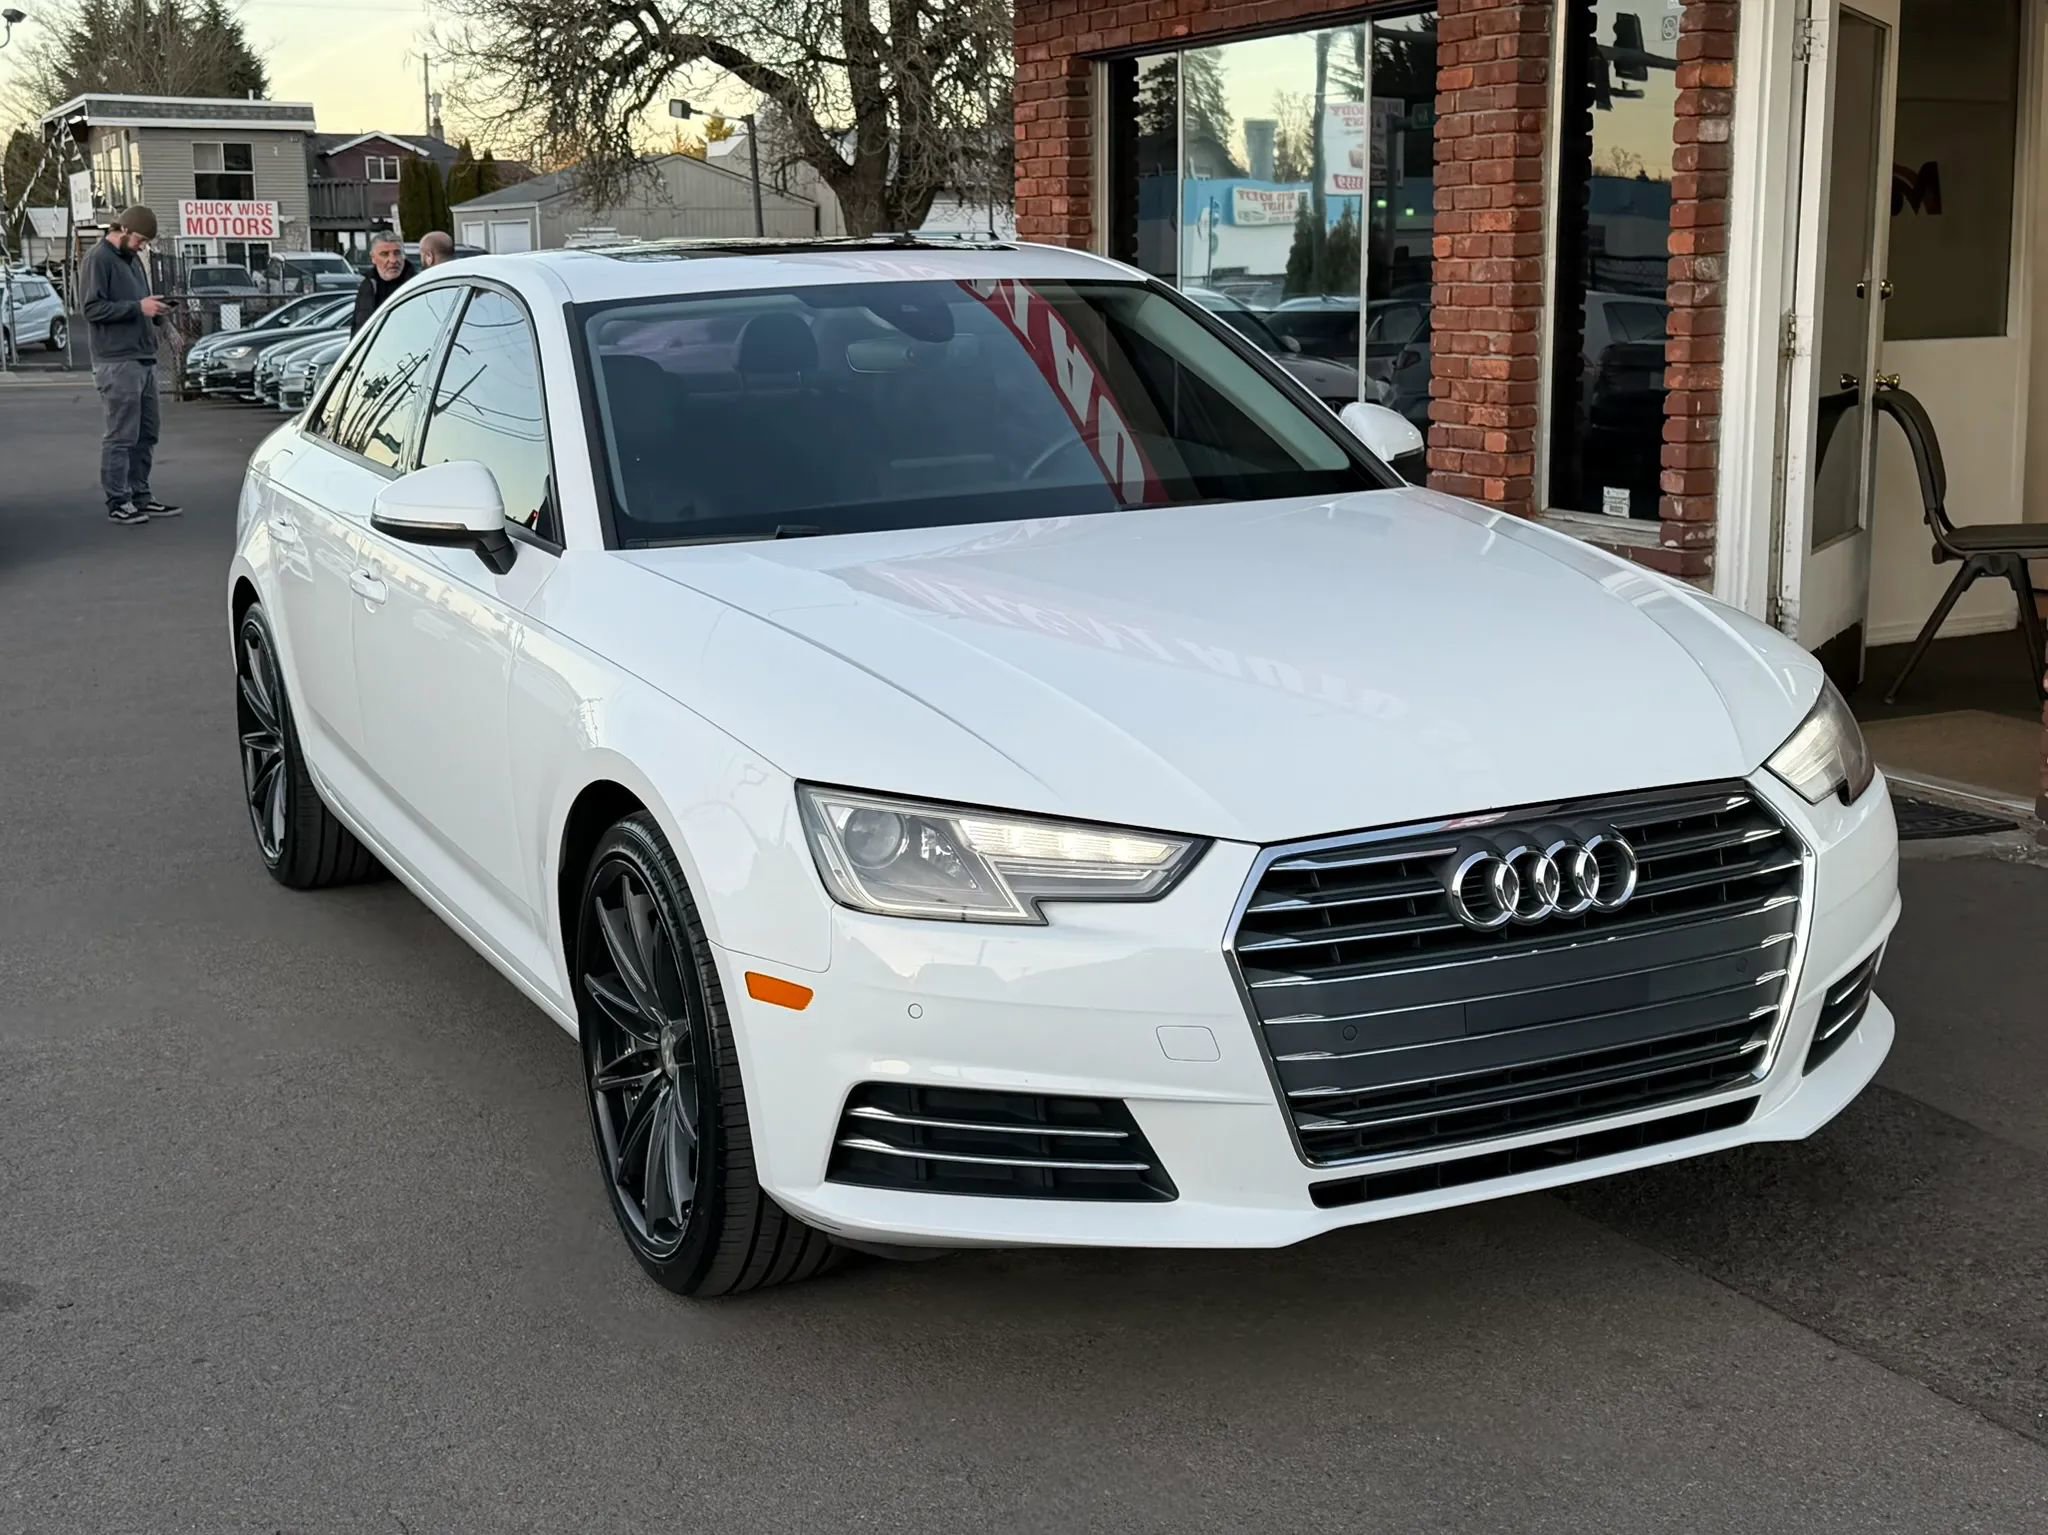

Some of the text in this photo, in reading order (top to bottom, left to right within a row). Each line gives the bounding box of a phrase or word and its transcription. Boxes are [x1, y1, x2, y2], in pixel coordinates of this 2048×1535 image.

[185, 202, 273, 216] CHUCK WISE
[186, 217, 273, 236] MOTORS
